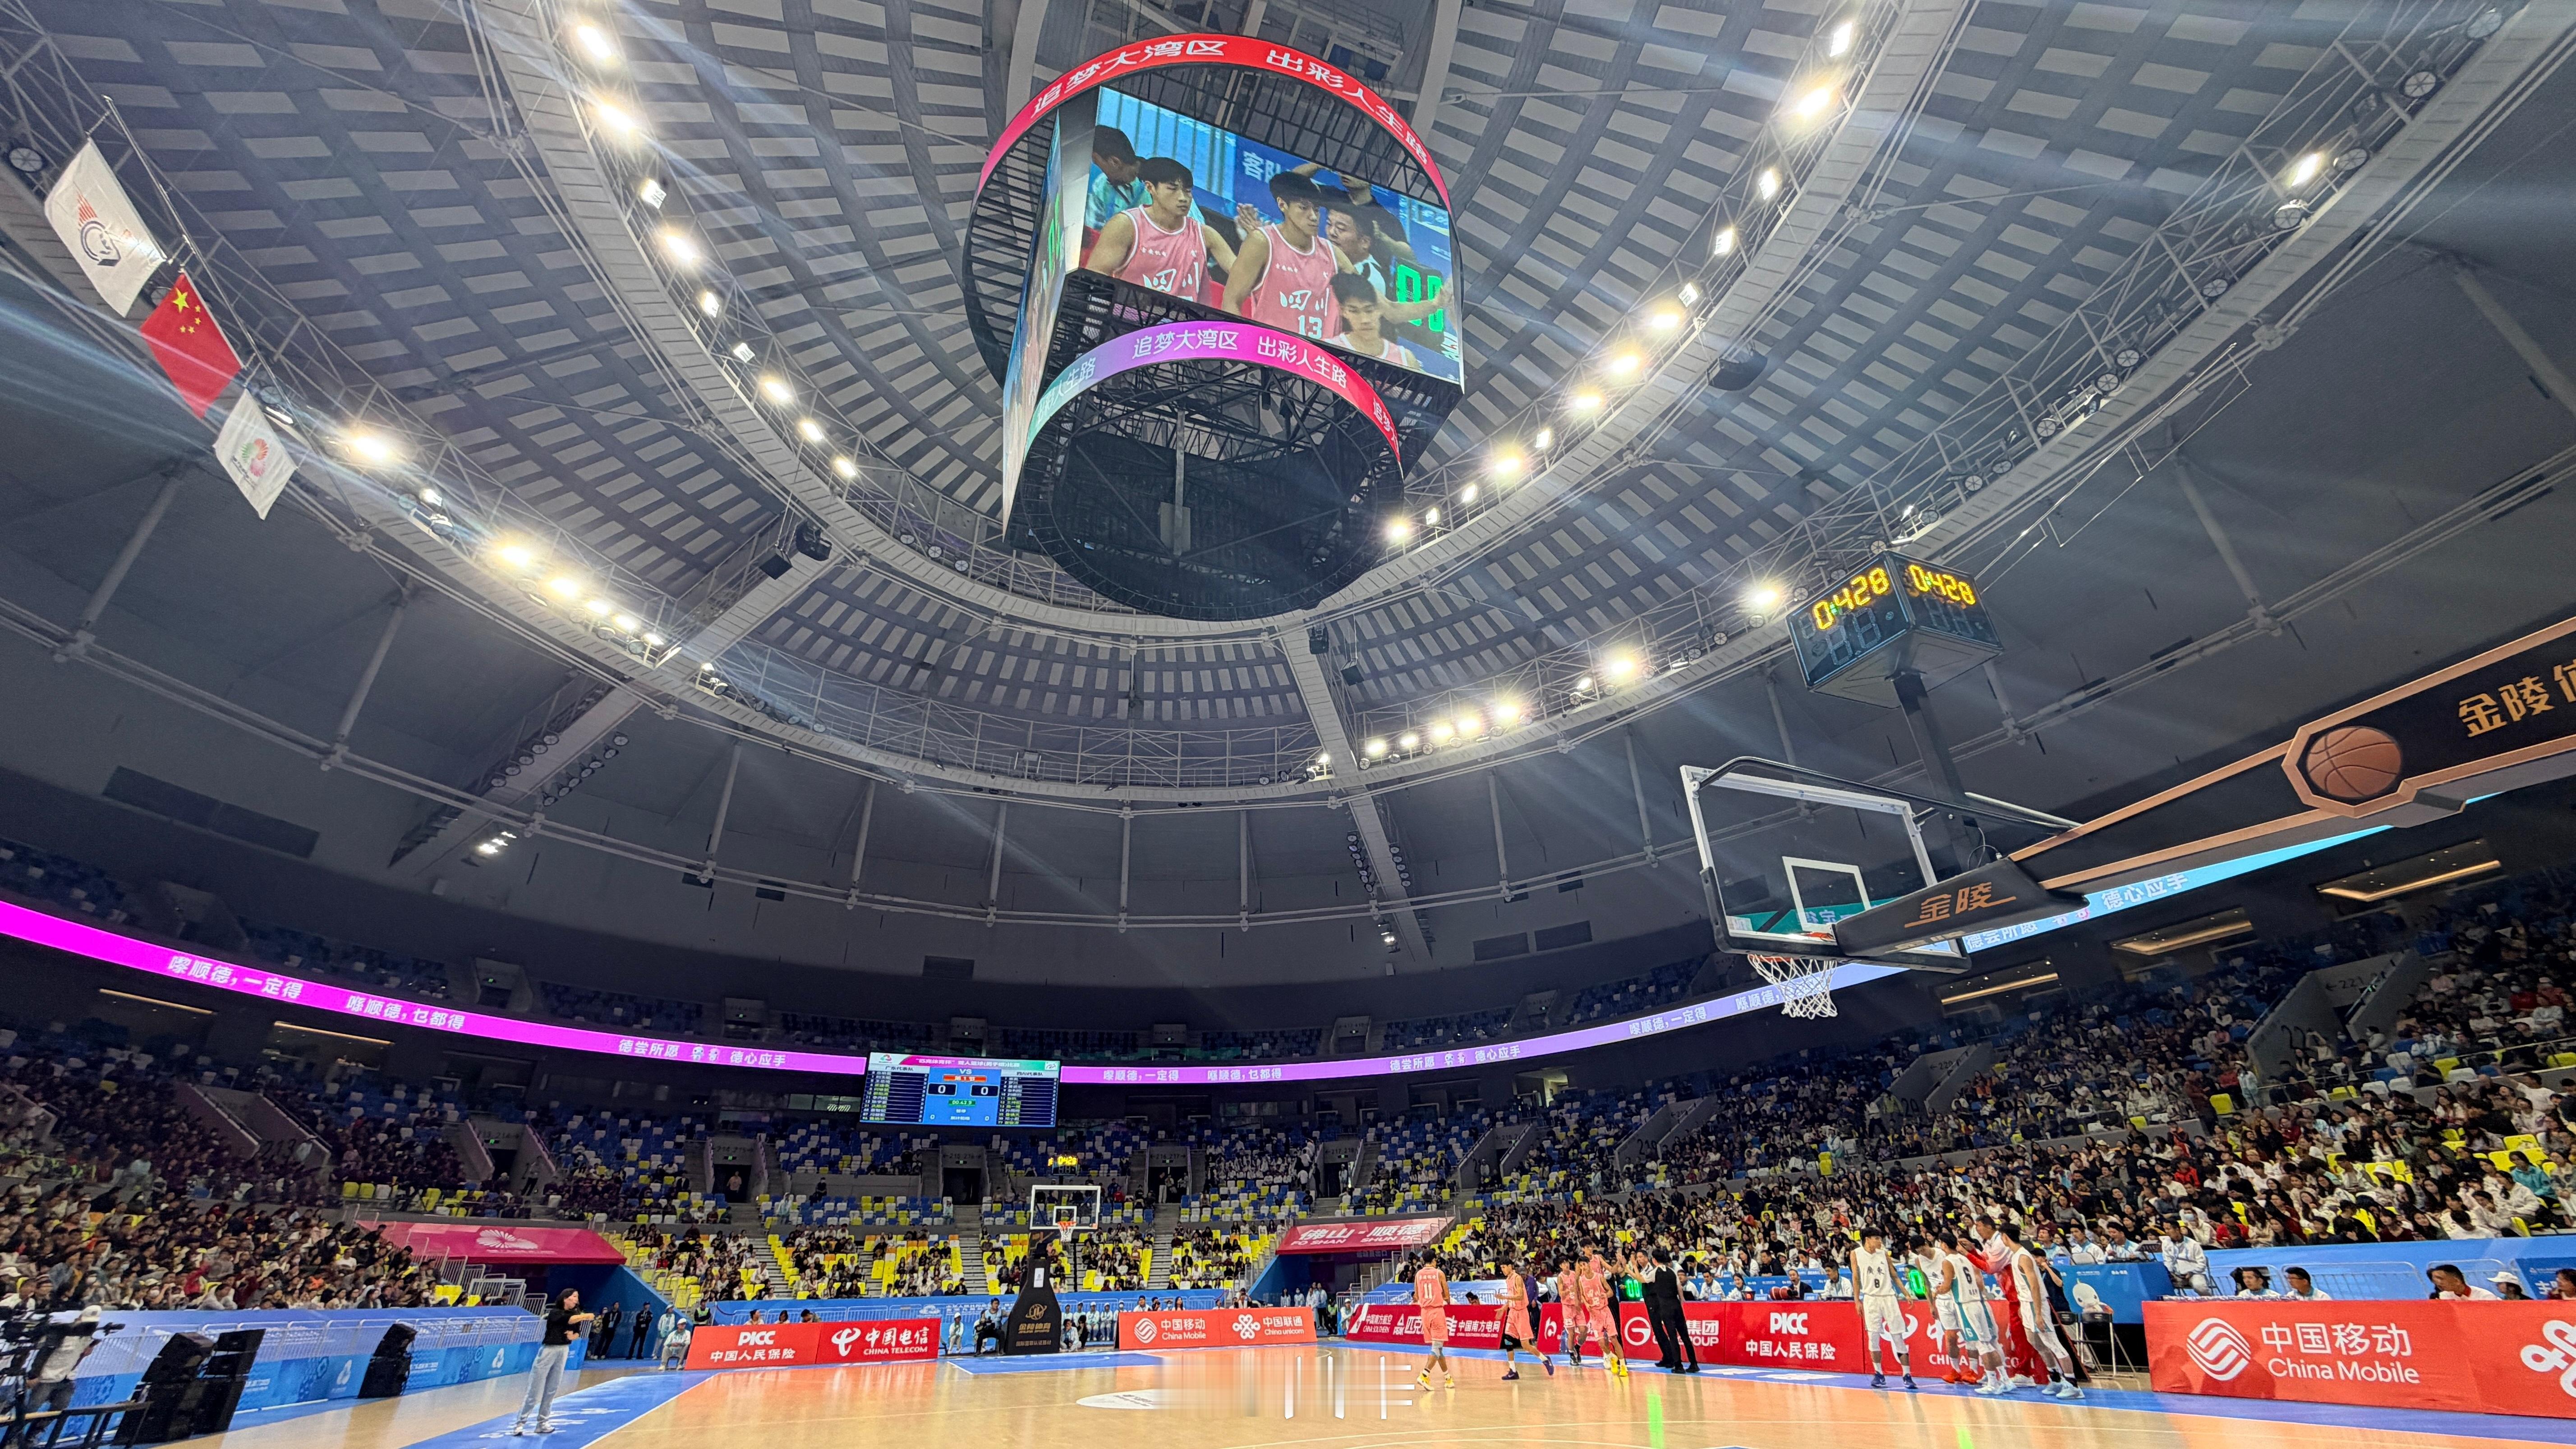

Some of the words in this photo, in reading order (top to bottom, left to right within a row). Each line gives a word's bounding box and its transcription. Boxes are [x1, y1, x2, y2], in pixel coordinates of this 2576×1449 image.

[1031, 41, 1227, 118] 追梦大湾区
[1266, 50, 1427, 164] 出彩人生路
[1298, 315, 1323, 340] 13
[1132, 329, 1239, 359] 追梦大湾区
[1257, 336, 1347, 388] 出彩人生路
[2101, 873, 2188, 910] 德心应手
[1904, 881, 2016, 928] 金陵
[730, 1050, 787, 1067] 德心应手
[1475, 1045, 1521, 1062] 德心应手
[938, 1085, 946, 1094] 0
[980, 1086, 989, 1095] 0
[1874, 1279, 1880, 1288] 8
[1963, 1266, 1972, 1284] 6
[1423, 1282, 1433, 1299] 11
[1161, 1317, 1205, 1331] 中国移动
[1262, 1316, 1303, 1328] 中国联通
[1458, 1320, 1501, 1332] 中国南方电网
[1770, 1312, 1808, 1335] PICC
[738, 1331, 776, 1346] PICC
[865, 1326, 929, 1348] 中国电信
[1162, 1332, 1182, 1340] China
[1183, 1331, 1206, 1340] Mobile
[1965, 1327, 1973, 1337] 6
[2260, 1321, 2412, 1357] 中国移动
[710, 1348, 796, 1362] 中国人民保险
[863, 1348, 889, 1356] CHINA
[891, 1346, 928, 1354] TELECOM
[1745, 1339, 1836, 1360] 中国人民保险
[2268, 1357, 2335, 1380] China
[2337, 1360, 2421, 1384] Mobile
